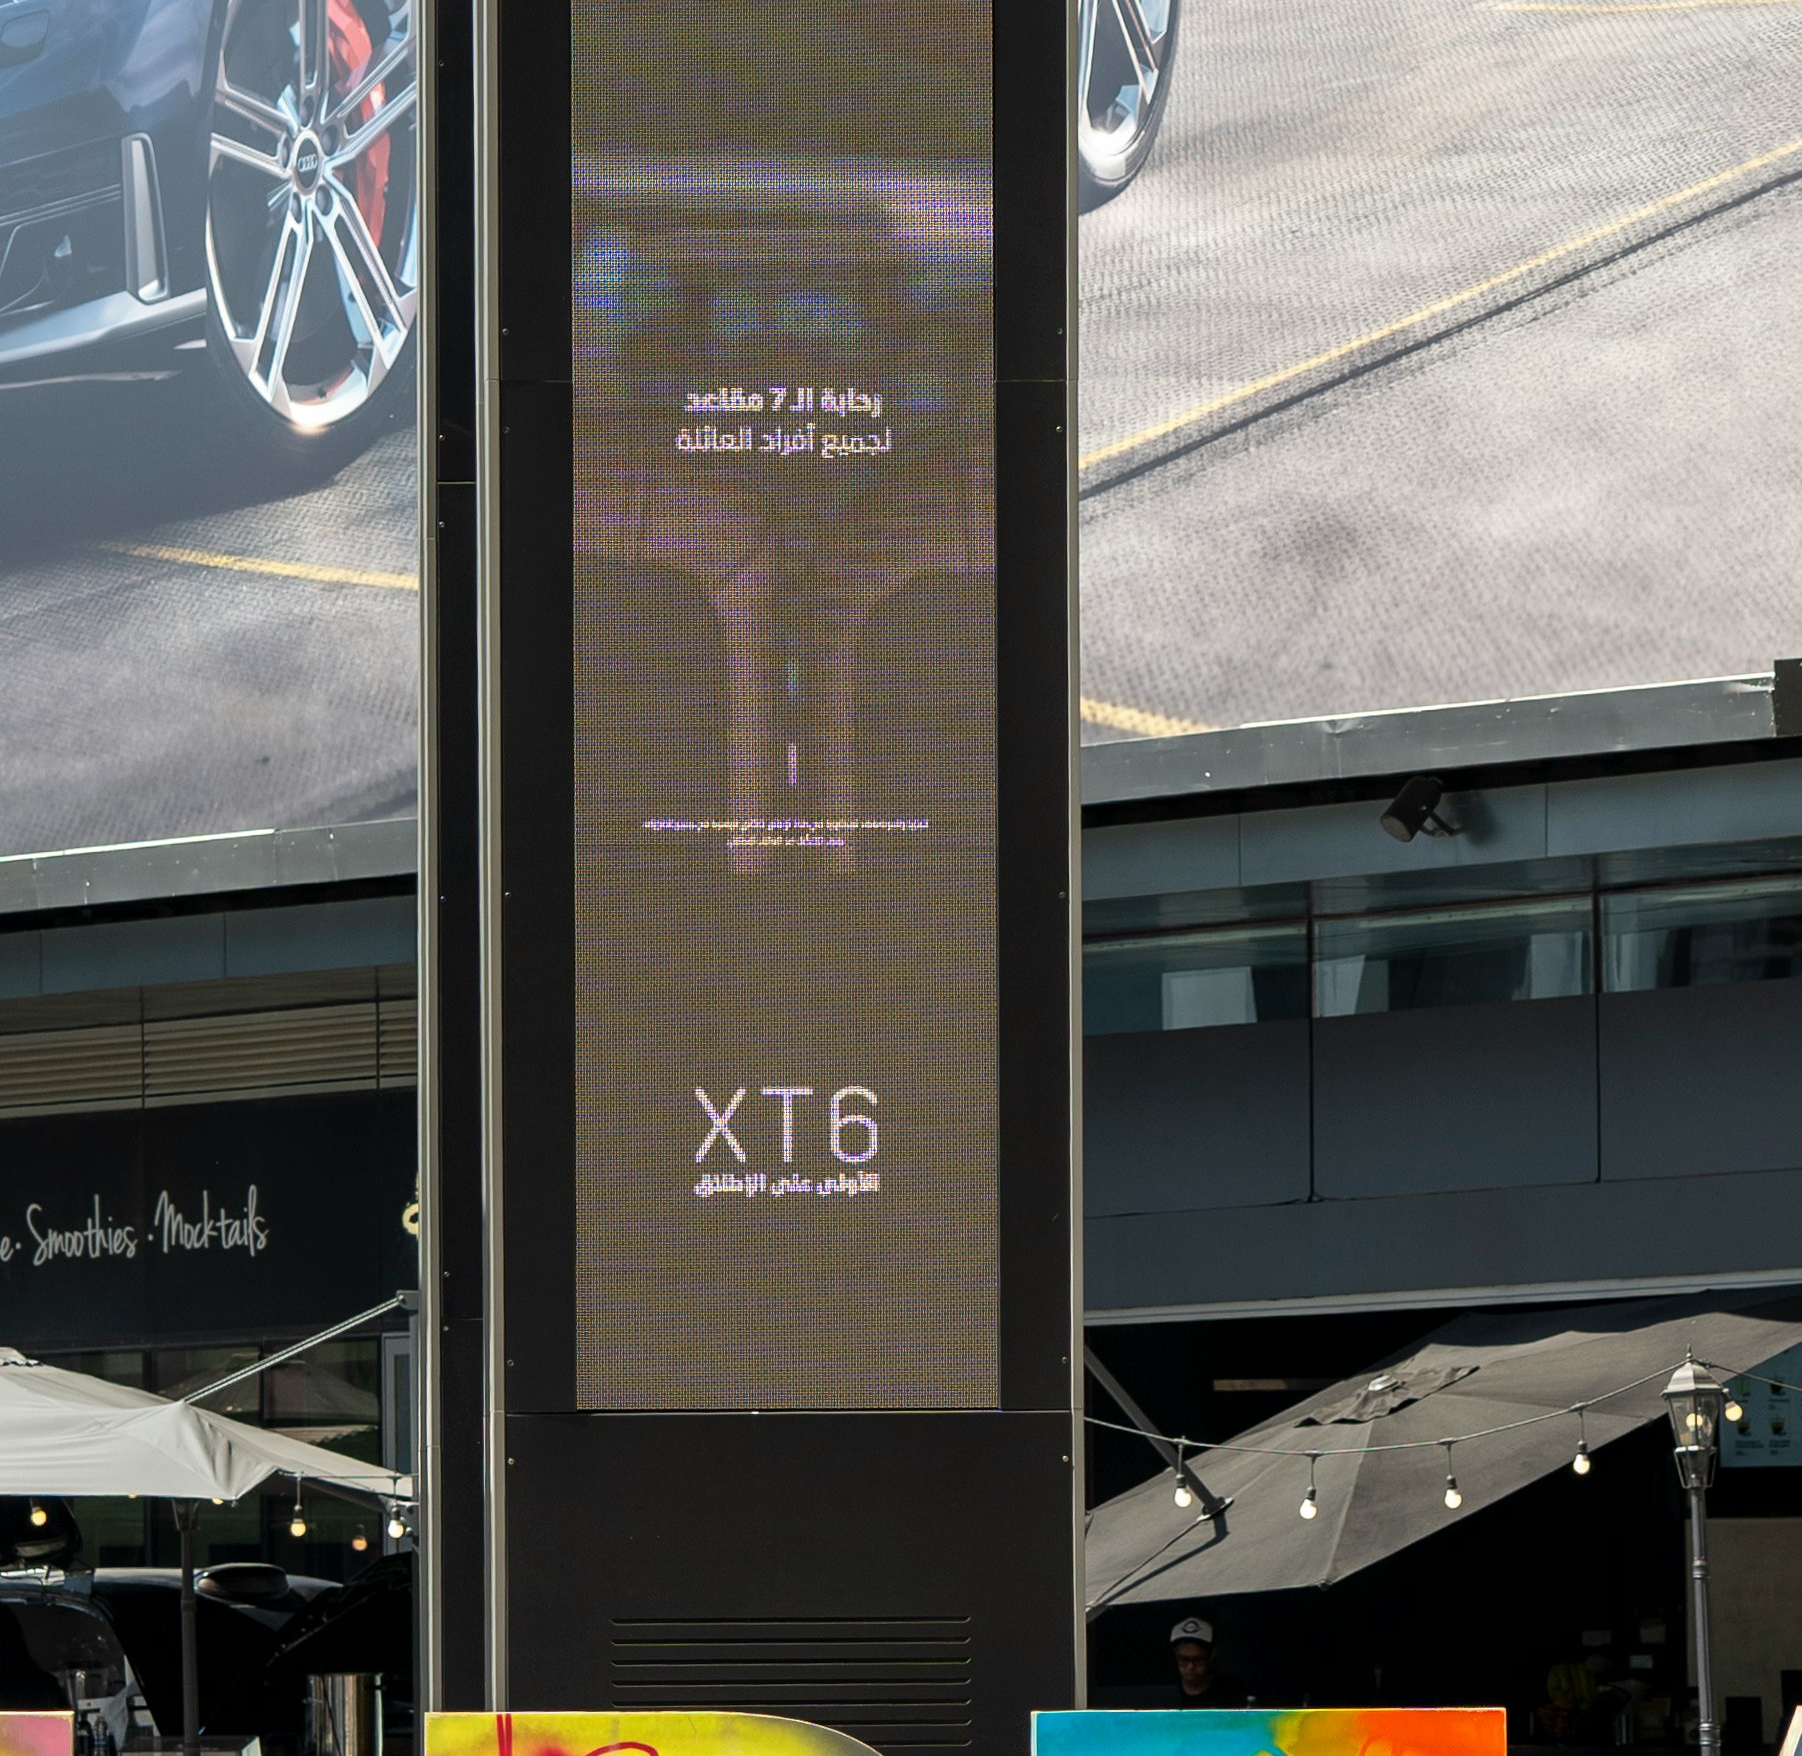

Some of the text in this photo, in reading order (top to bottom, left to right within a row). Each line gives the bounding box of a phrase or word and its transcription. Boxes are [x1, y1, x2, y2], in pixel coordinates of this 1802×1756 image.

[683, 387, 764, 412] مقاعد
[821, 387, 883, 418] رحابة
[674, 422, 892, 459] لجميع أفراد العائلة
[695, 1085, 878, 1163] XT6
[770, 1172, 813, 1198] على
[26, 1193, 138, 1266] Smoothies
[154, 1184, 270, 1257] Mocktails
